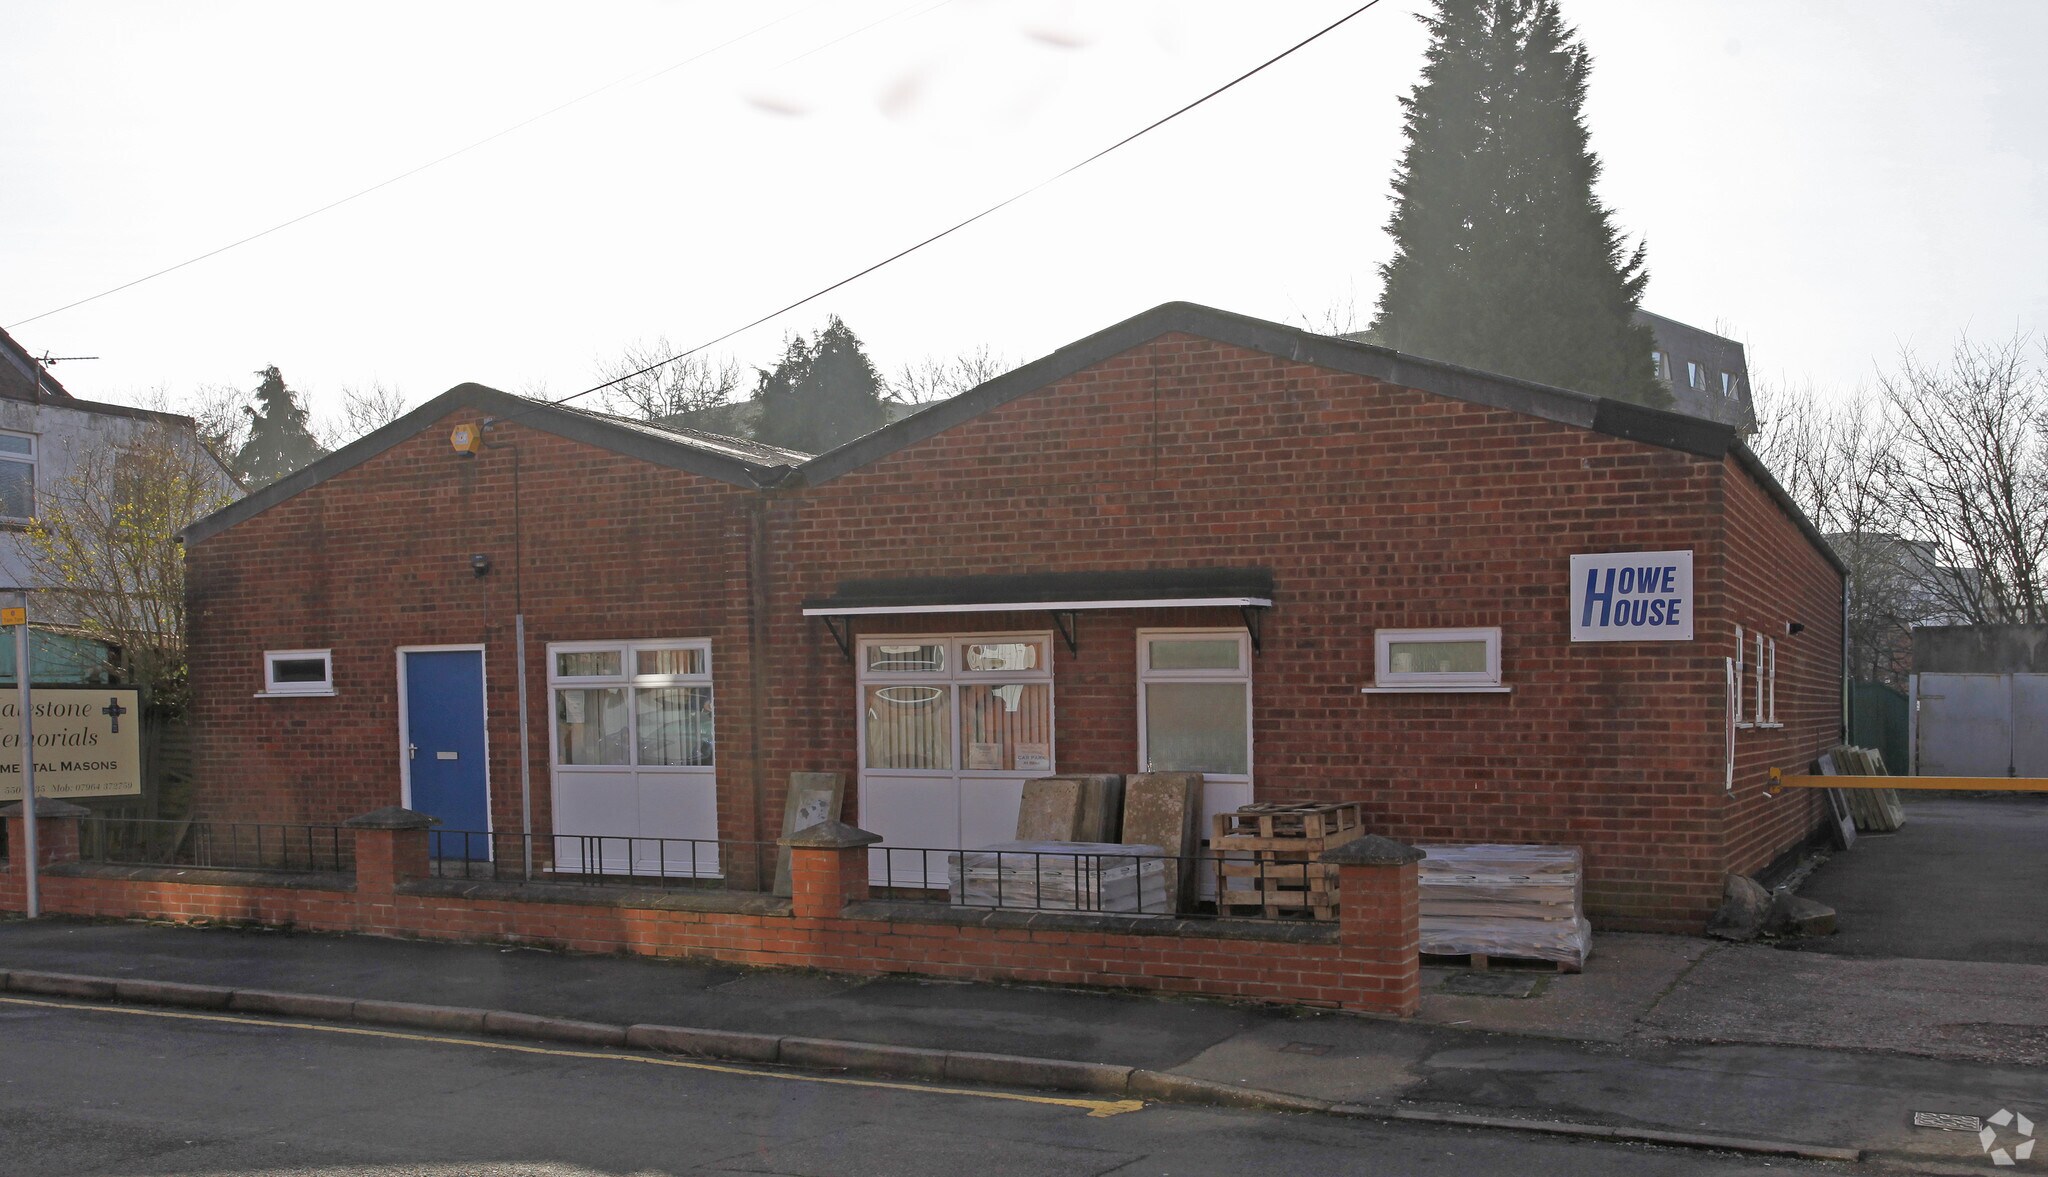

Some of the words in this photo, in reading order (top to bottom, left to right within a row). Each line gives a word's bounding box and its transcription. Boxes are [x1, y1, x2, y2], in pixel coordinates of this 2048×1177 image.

[1582, 567, 1676, 627] HOWE
[0, 697, 92, 718] astone
[0, 726, 98, 748] eorials
[0, 763, 57, 774] METAL
[60, 760, 118, 771] MASONS
[52, 783, 73, 792] Mob:
